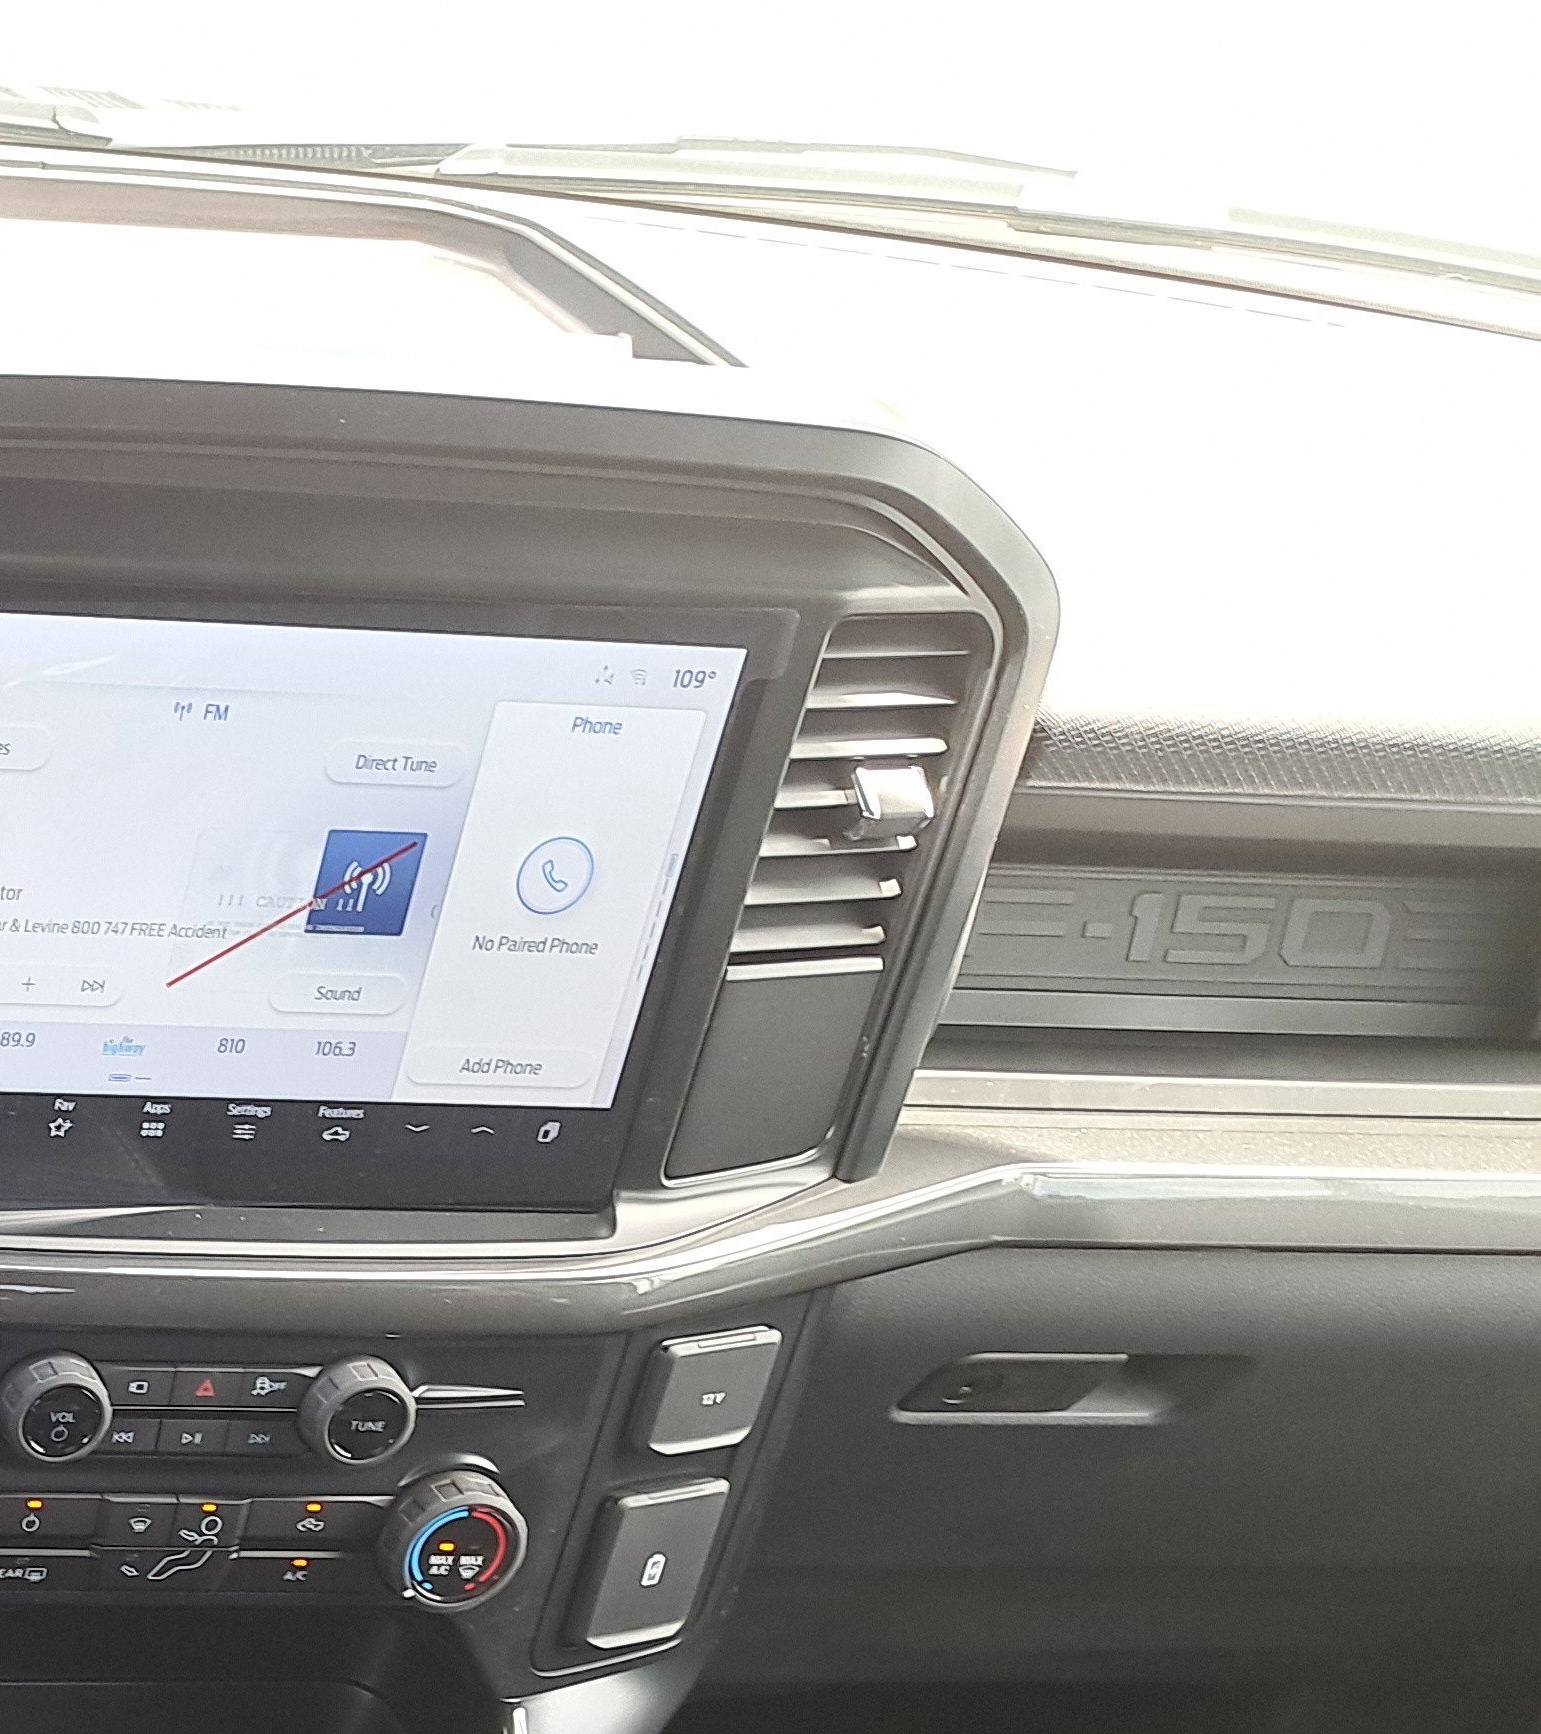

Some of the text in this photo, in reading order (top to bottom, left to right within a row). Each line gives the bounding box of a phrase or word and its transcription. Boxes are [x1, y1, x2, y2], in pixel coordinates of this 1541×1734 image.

[672, 668, 717, 690] 109°
[203, 703, 230, 722] FM
[571, 716, 623, 735] Phone
[355, 754, 437, 774] Direct Tune
[10, 918, 21, 932] &
[23, 918, 69, 935] Levine
[71, 920, 101, 936] 800
[102, 921, 128, 936] 747
[129, 922, 166, 938] FREE
[168, 925, 227, 941] Accident
[471, 935, 598, 956] No Paired Phone
[314, 985, 362, 1002] Sound
[0, 1031, 36, 1048] 89.9
[217, 1038, 246, 1055] 810
[315, 1040, 356, 1057] 106.3
[459, 1058, 542, 1076] Add Phone
[50, 1411, 75, 1424] VOL
[351, 1420, 386, 1433] TUNE
[283, 1570, 307, 1582] A/C
